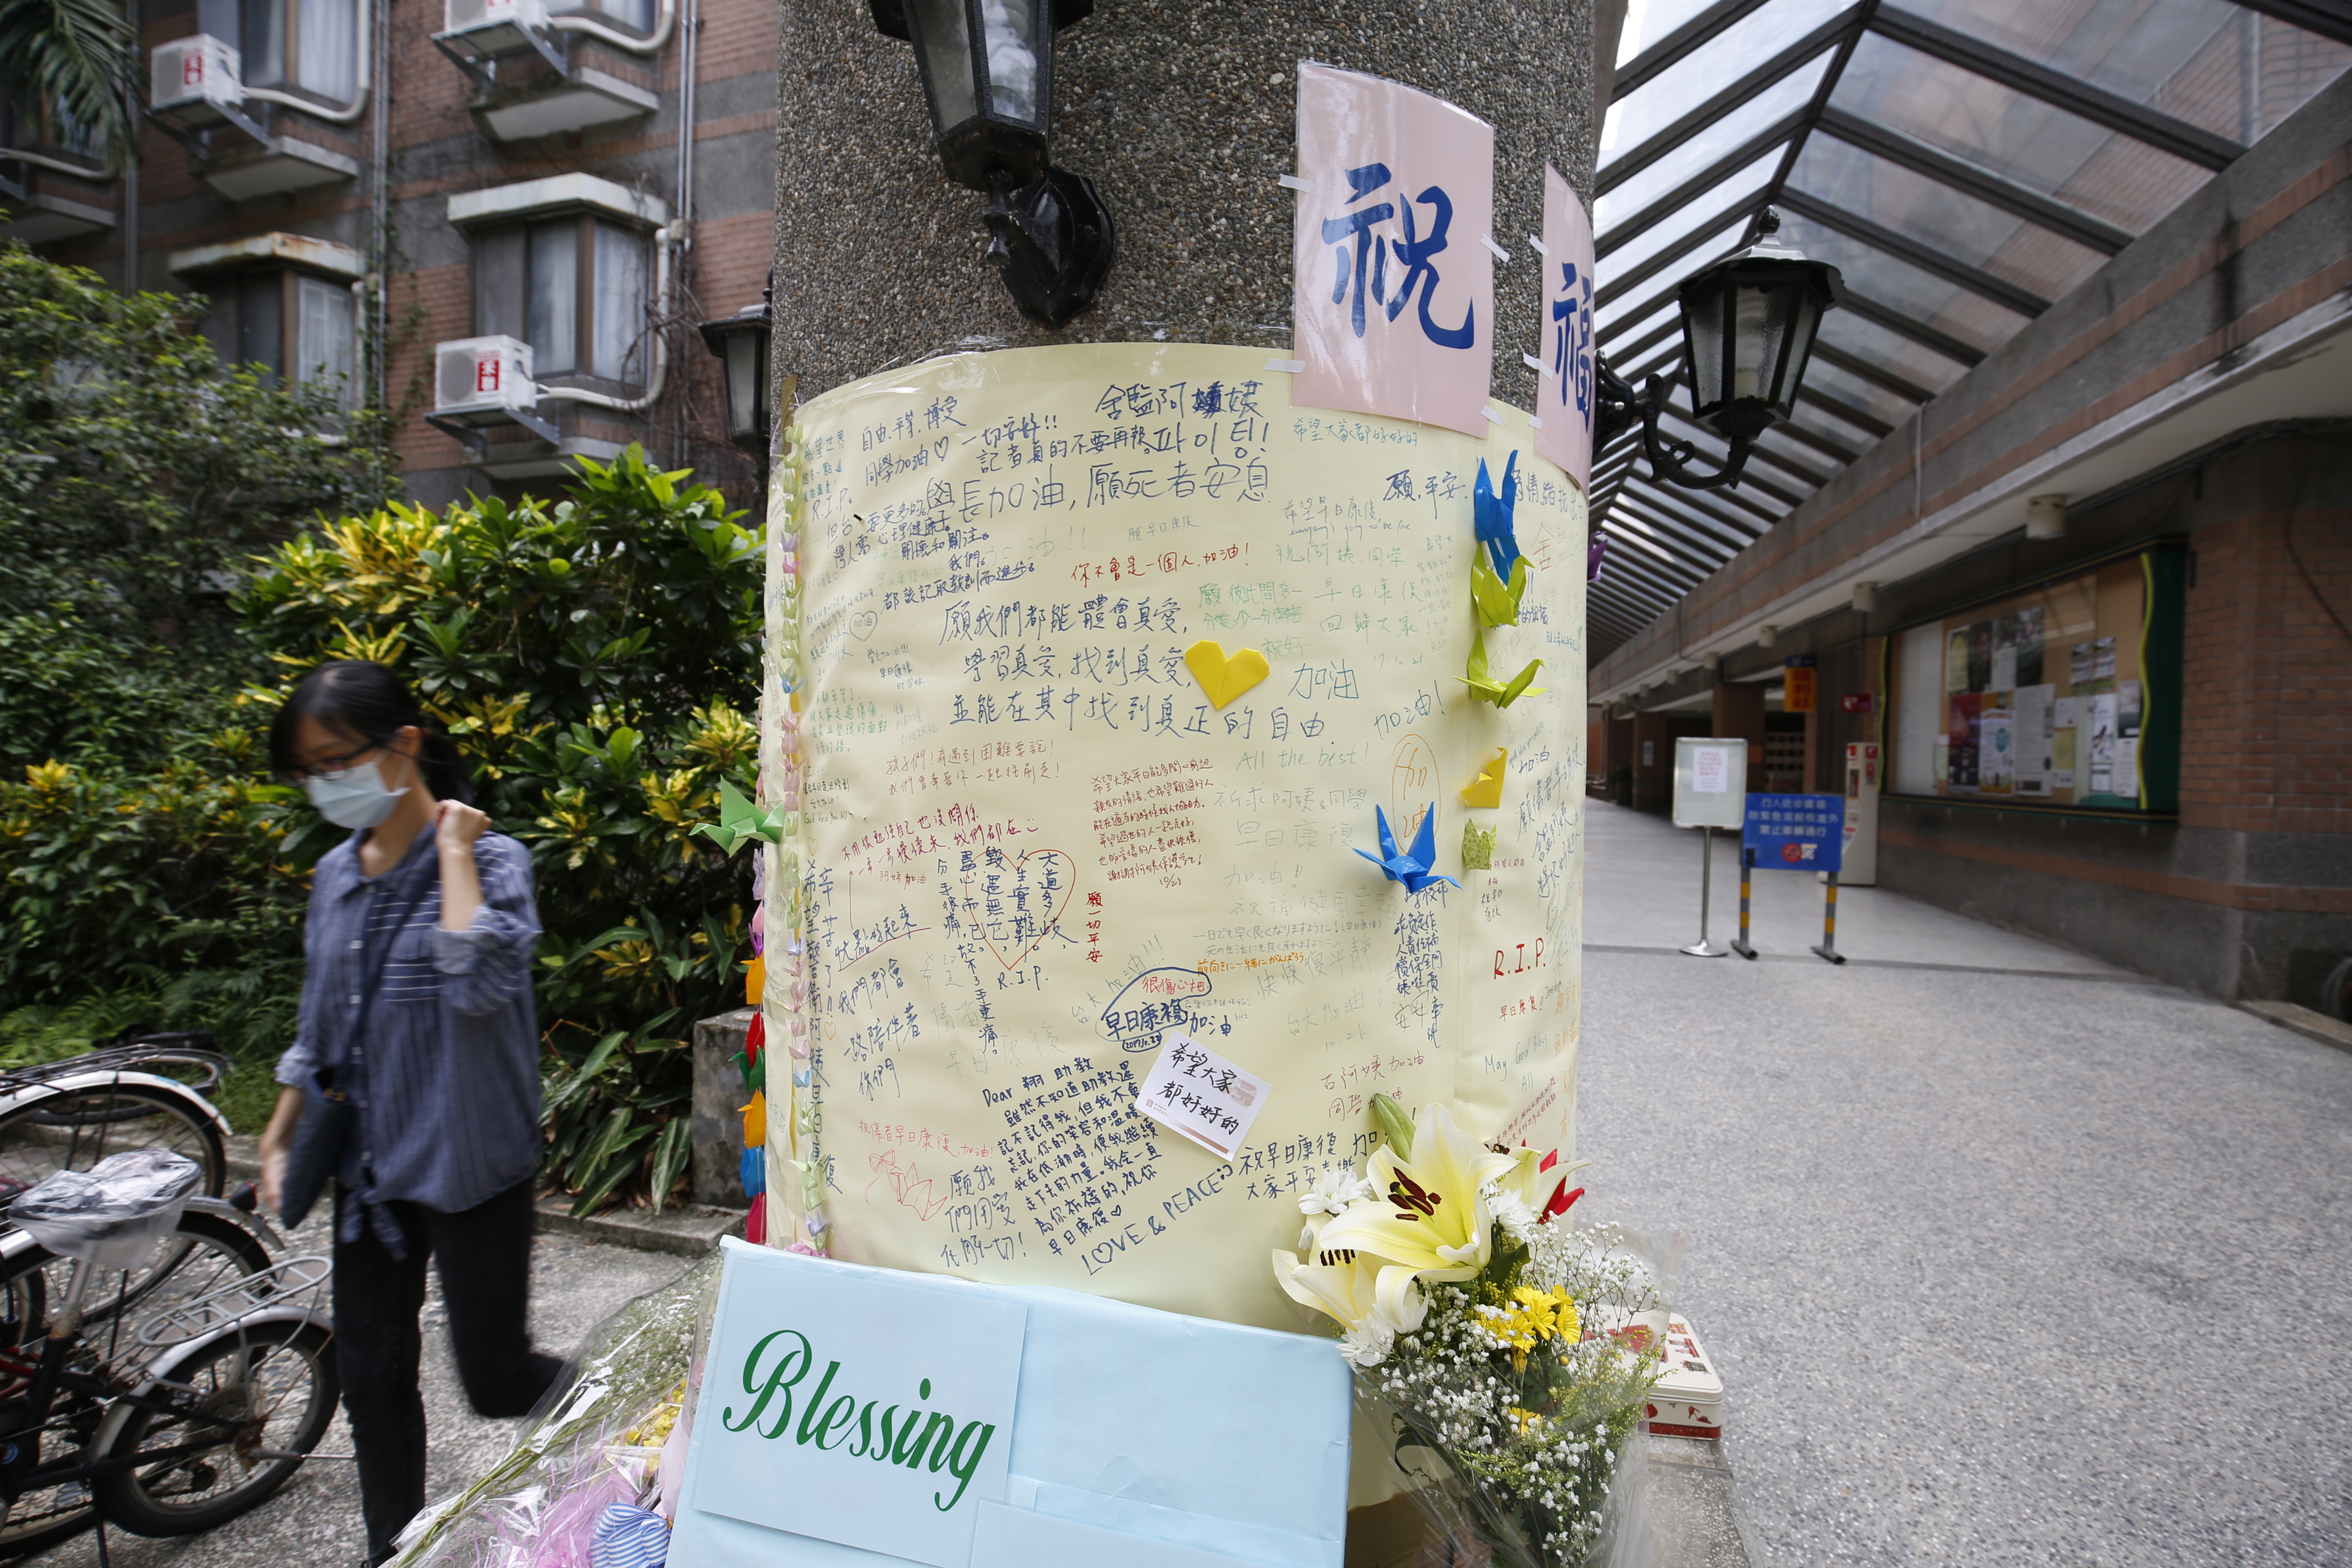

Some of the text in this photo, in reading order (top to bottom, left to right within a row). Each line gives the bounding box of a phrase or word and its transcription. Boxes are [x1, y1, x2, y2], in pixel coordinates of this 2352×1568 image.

[1322, 162, 1474, 349] 祝
[1552, 261, 1595, 433] 福
[1293, 417, 1418, 446] 希望大家都好好的
[854, 619, 872, 628] 加油
[1287, 658, 1359, 700] 加油
[1236, 750, 1265, 771] All
[1279, 747, 1305, 769] the
[1518, 745, 1550, 774] 加油
[1085, 891, 1103, 963] 願一切平安
[1493, 937, 1547, 980] R.I.P.
[1189, 1011, 1232, 1037] 加油
[982, 1087, 1013, 1107] Dear
[1054, 1057, 1095, 1080] 助教
[1169, 1042, 1237, 1095] 希望大家
[1484, 1054, 1508, 1082] May
[1515, 1037, 1530, 1065] God
[1521, 1071, 1534, 1093] All
[1155, 1080, 1239, 1136] 都好好的
[1238, 1131, 1338, 1177] 祝早日康復
[1148, 1215, 1167, 1236] &
[1163, 1172, 1223, 1221] PEACE
[1048, 1207, 1110, 1256] 早日康復
[723, 1330, 996, 1512] Blessing
